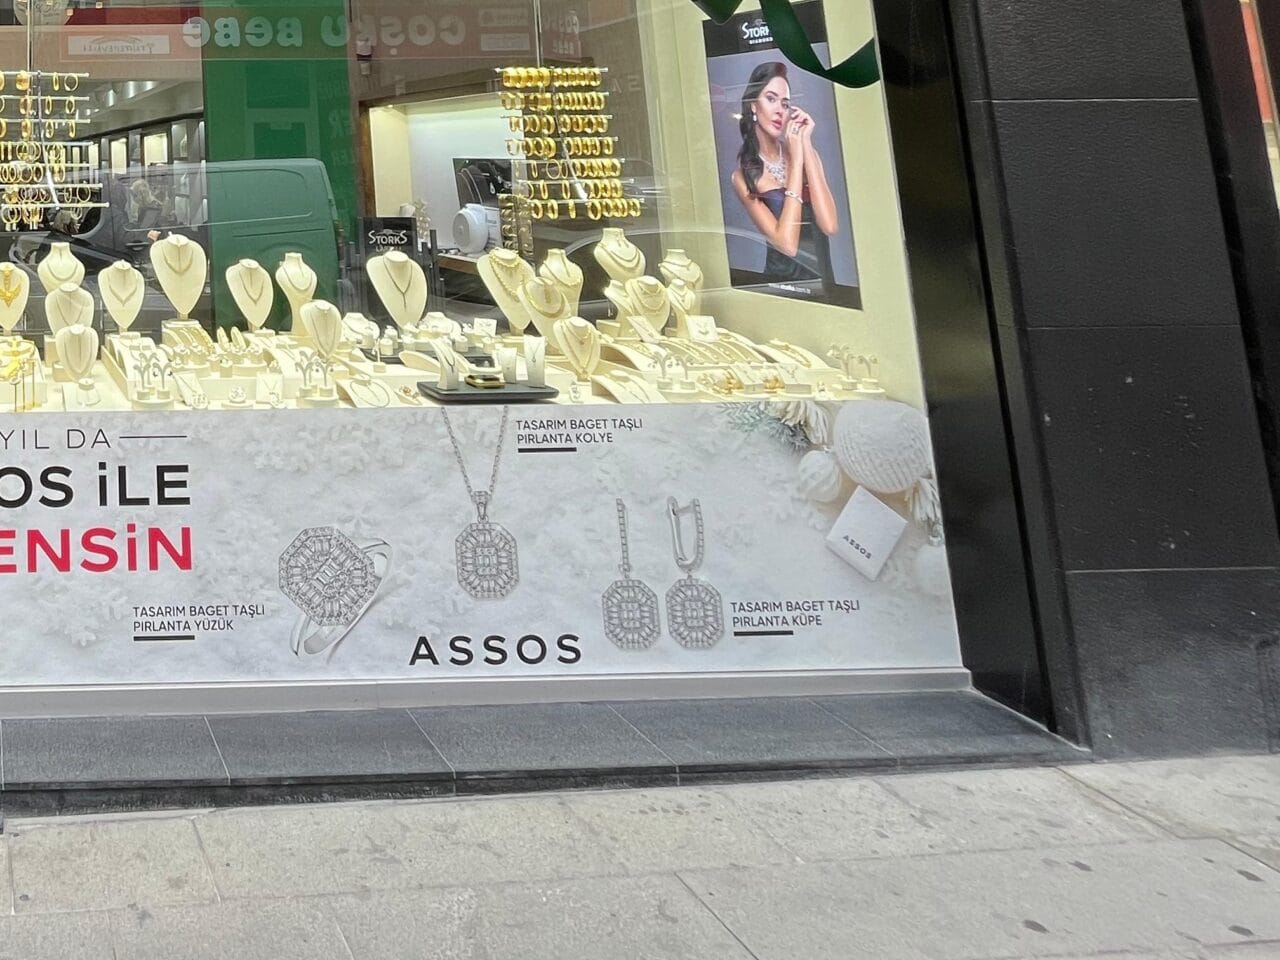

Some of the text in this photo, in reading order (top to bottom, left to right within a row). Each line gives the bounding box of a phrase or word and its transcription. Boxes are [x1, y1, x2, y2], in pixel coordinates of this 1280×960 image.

[368, 230, 408, 245] STORKS
[516, 418, 643, 431] TASARIM BAGET TAŞLI
[66, 428, 111, 449] DA
[517, 432, 613, 444] PIRLANTA KOLYE
[842, 534, 872, 559] ASSOS
[133, 604, 265, 618] TASARIM BAGET TAŞLI
[731, 600, 860, 613] TASARIM BAGET TAŞLI
[133, 617, 234, 632] PIRLANTA YÜZÜK
[733, 613, 822, 627] PIRLANTA KÜPE
[409, 634, 582, 666] ASSOS
